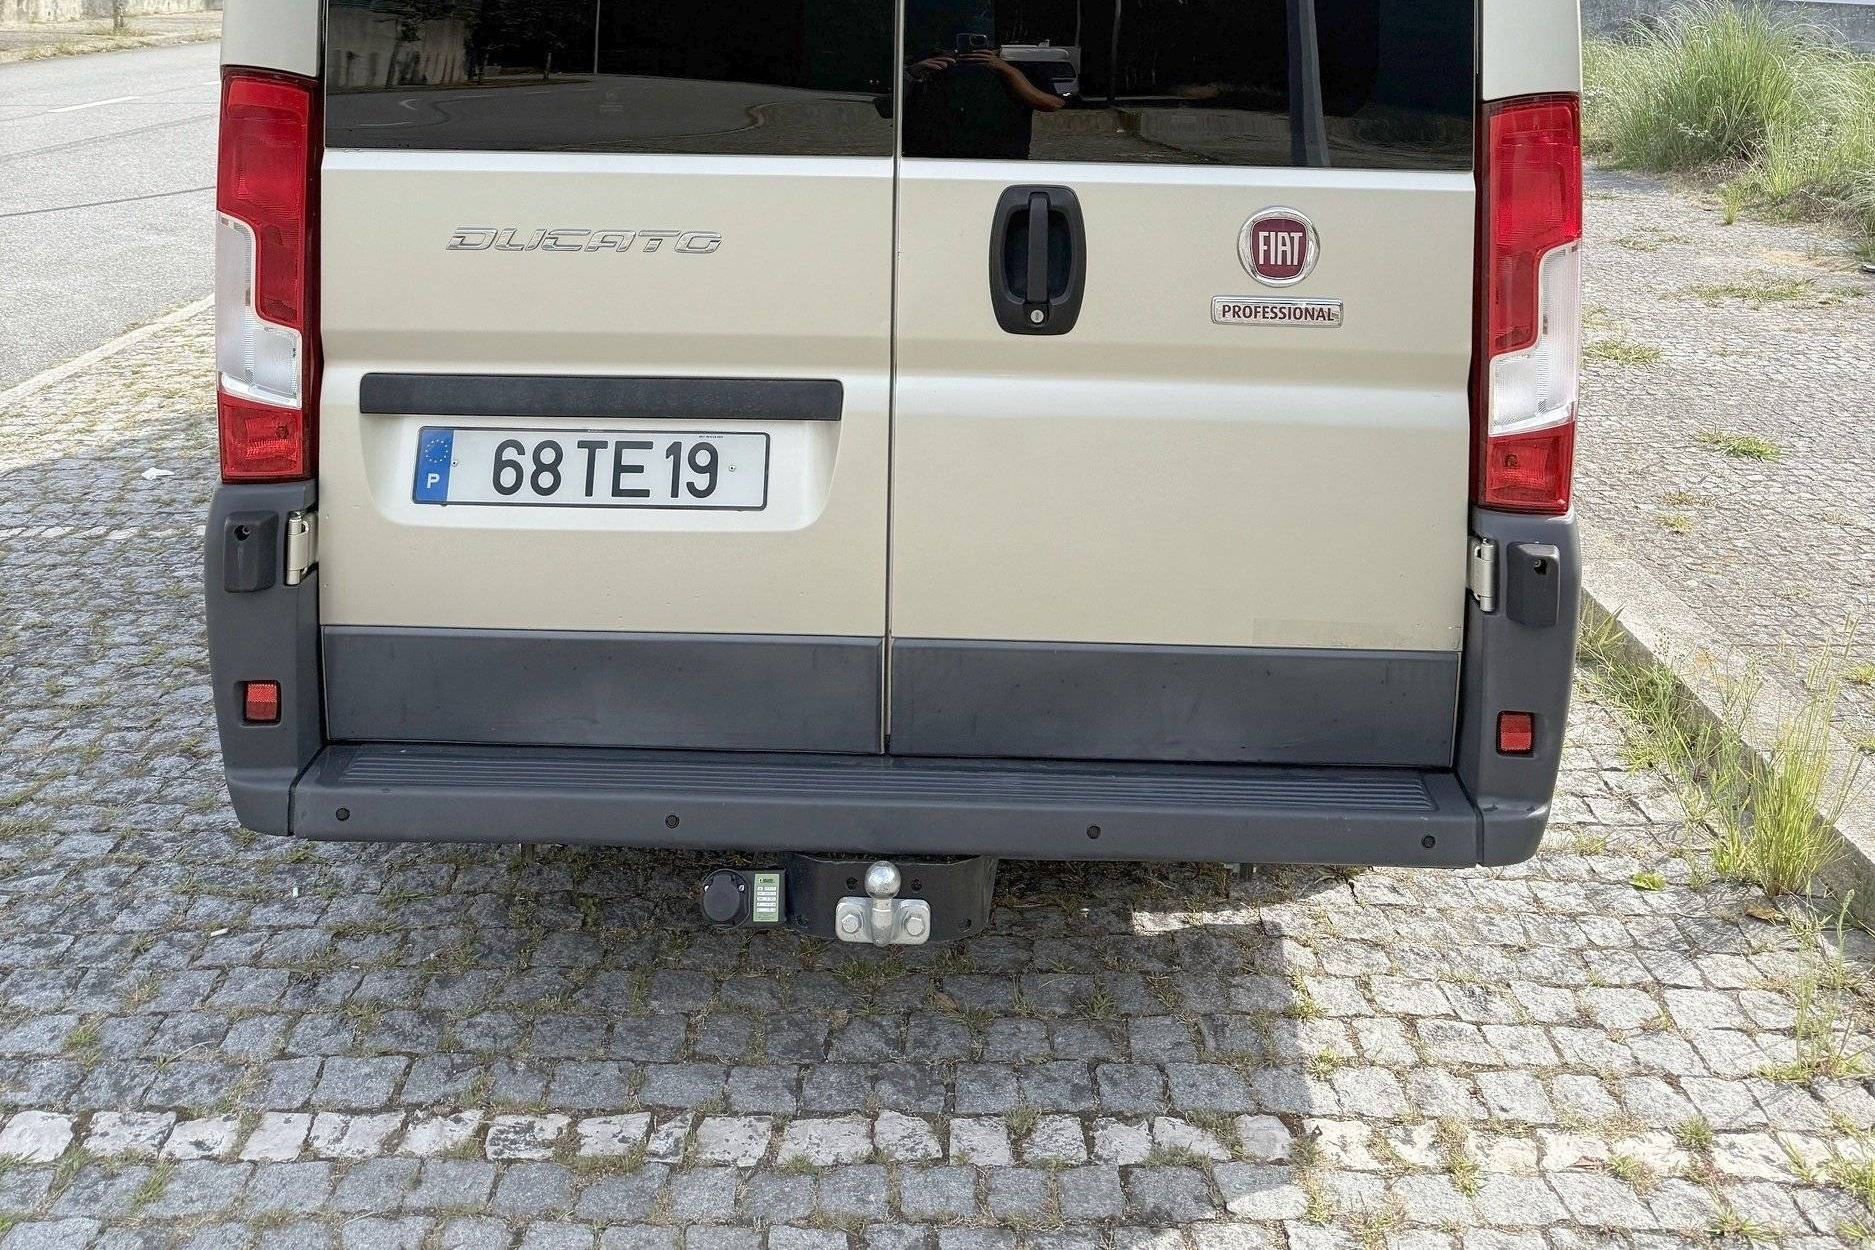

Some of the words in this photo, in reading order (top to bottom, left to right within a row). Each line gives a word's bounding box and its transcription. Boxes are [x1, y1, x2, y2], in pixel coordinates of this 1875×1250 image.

[446, 227, 722, 254] DUCATO
[1258, 231, 1303, 266] FIAT
[1221, 304, 1335, 322] PROFESSIONAL
[425, 472, 441, 489] P
